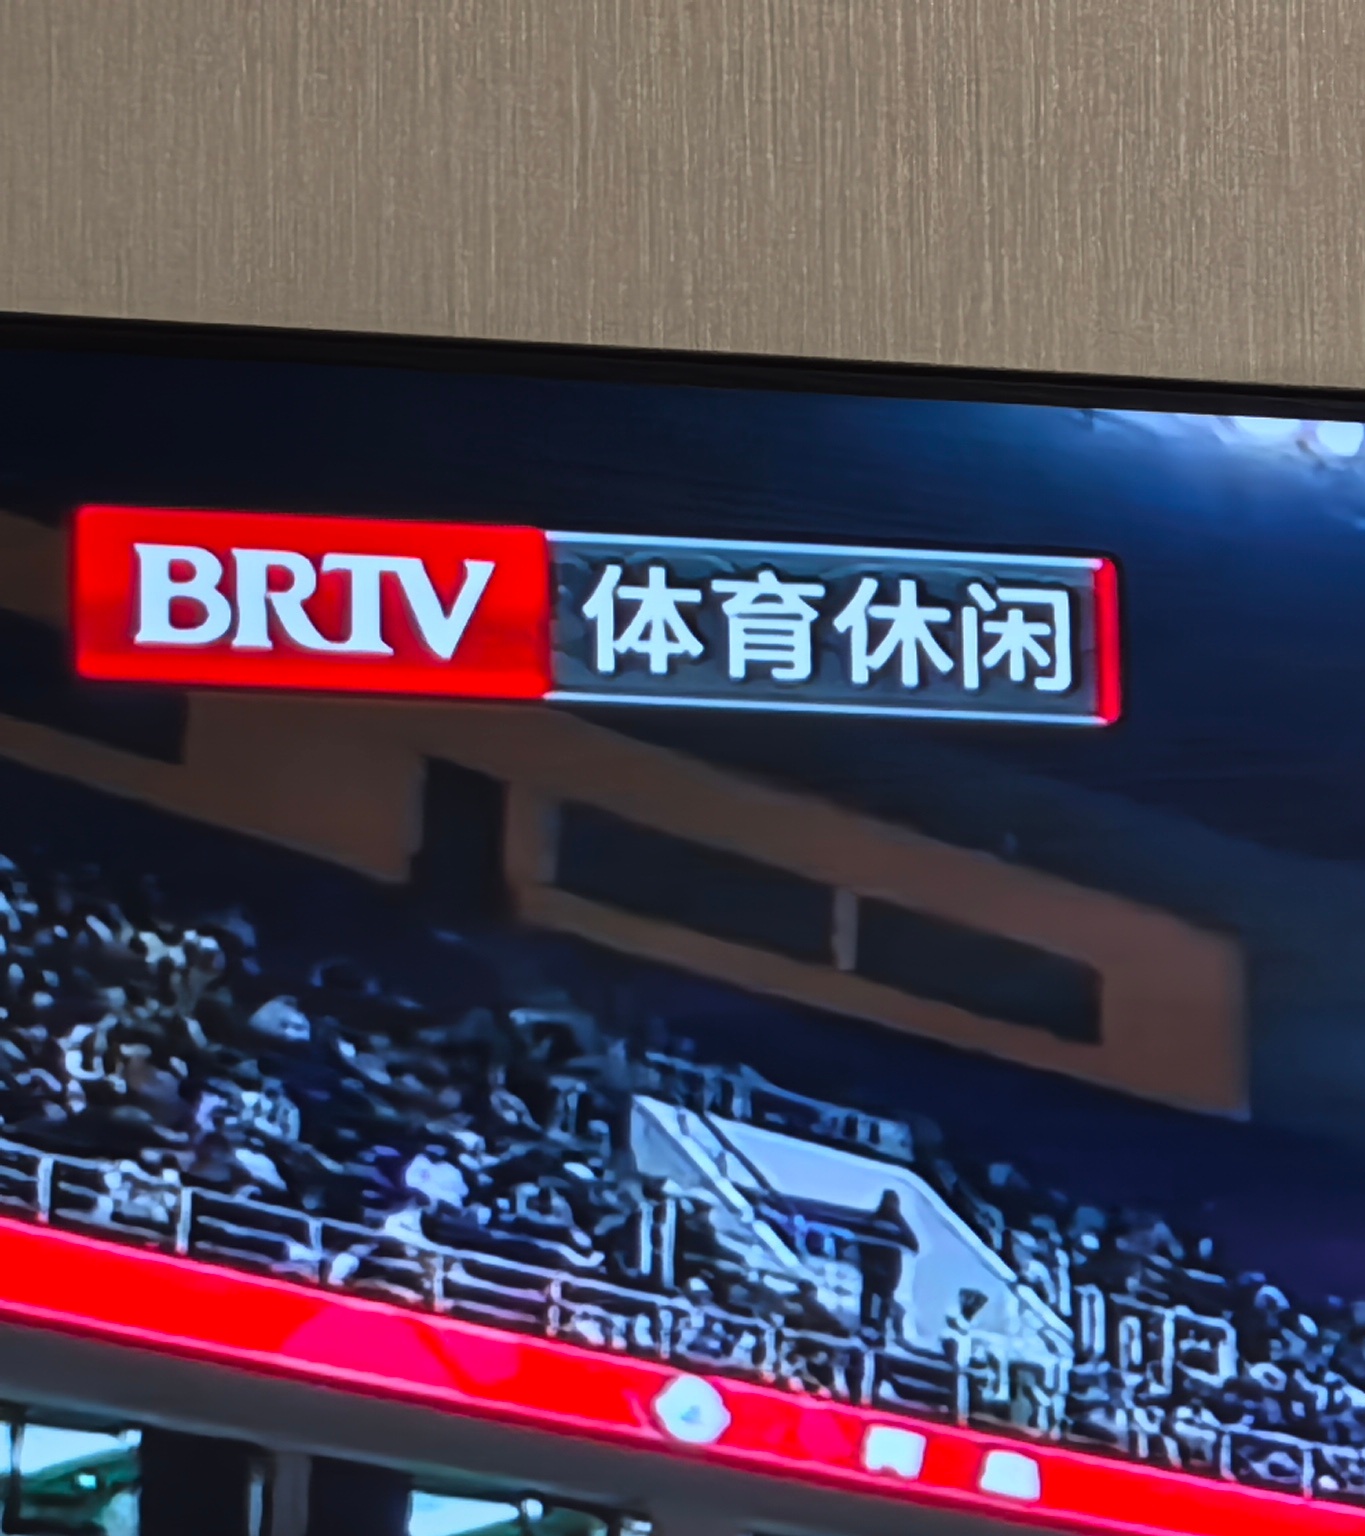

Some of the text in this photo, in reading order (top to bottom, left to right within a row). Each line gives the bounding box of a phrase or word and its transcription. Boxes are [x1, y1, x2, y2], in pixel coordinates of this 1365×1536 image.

[134, 543, 1072, 693] BRTV 体育休闲
